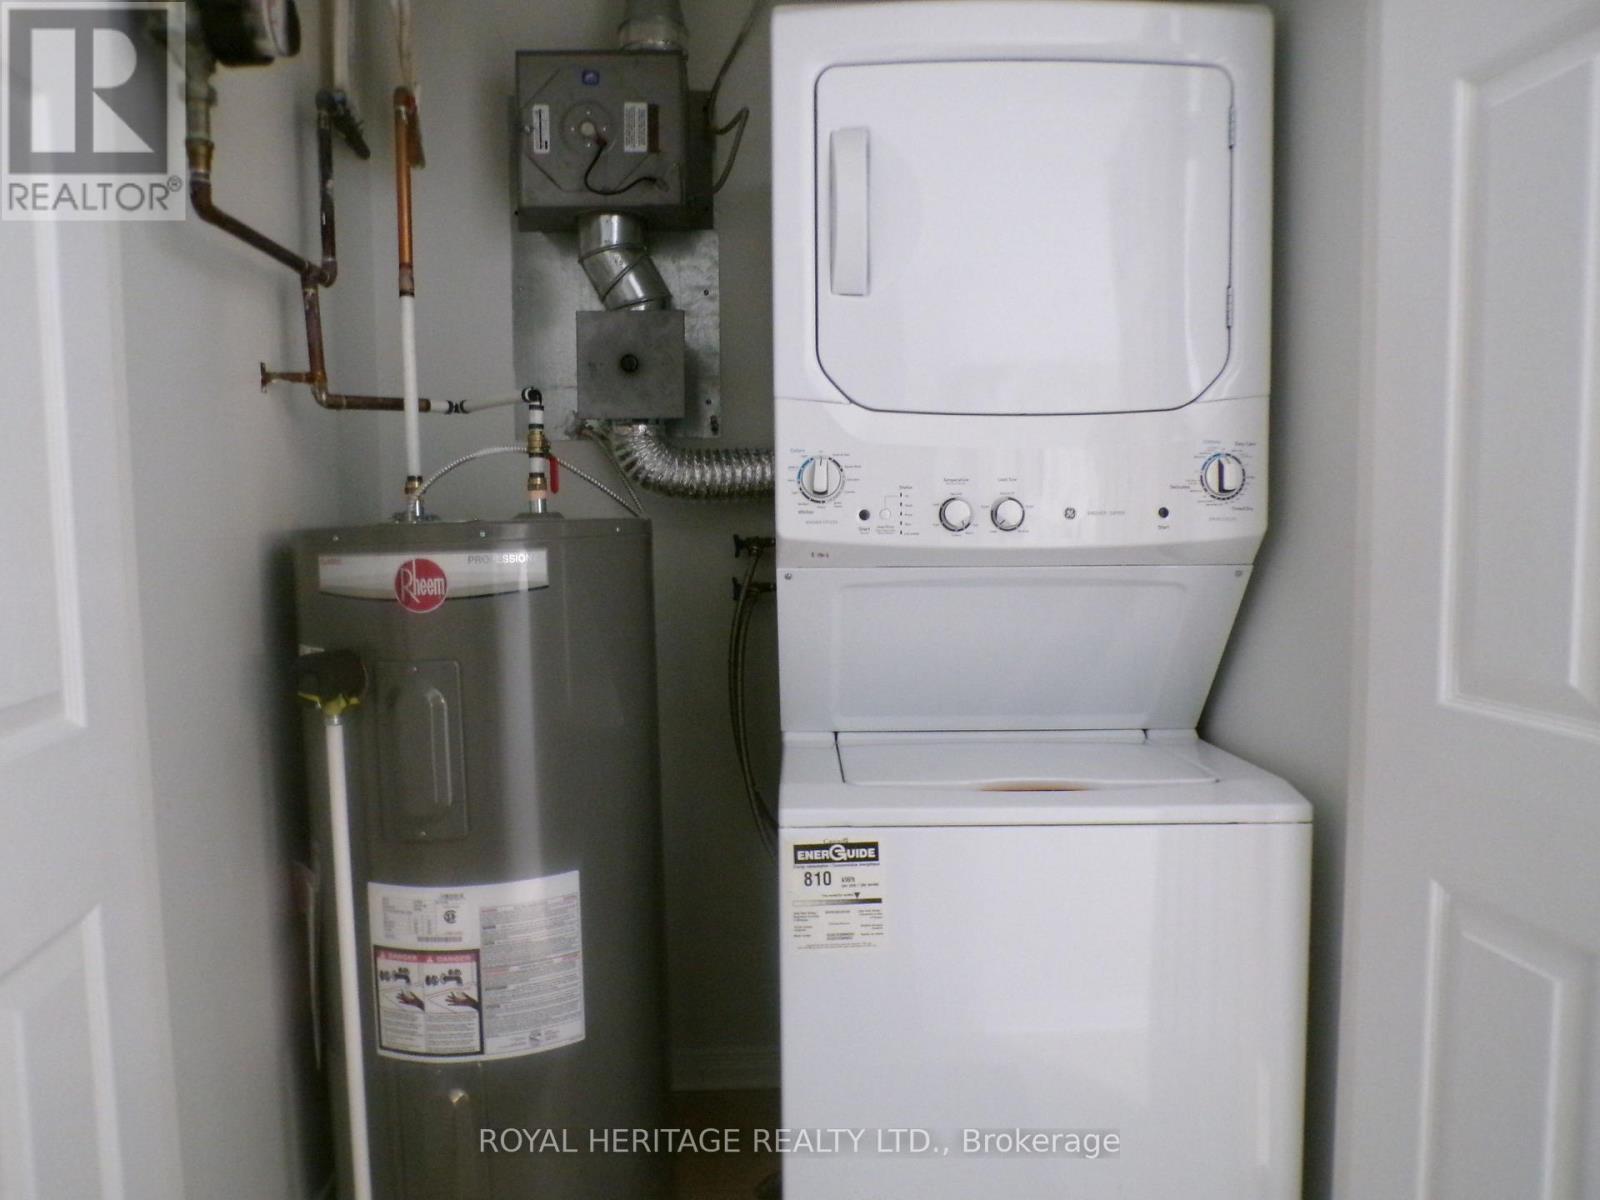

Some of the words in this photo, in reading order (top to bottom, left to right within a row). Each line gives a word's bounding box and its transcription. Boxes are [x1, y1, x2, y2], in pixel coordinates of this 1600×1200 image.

[401, 560, 445, 604] Rheem
[797, 844, 876, 861] ENERGUIDE
[804, 871, 832, 886] 810
